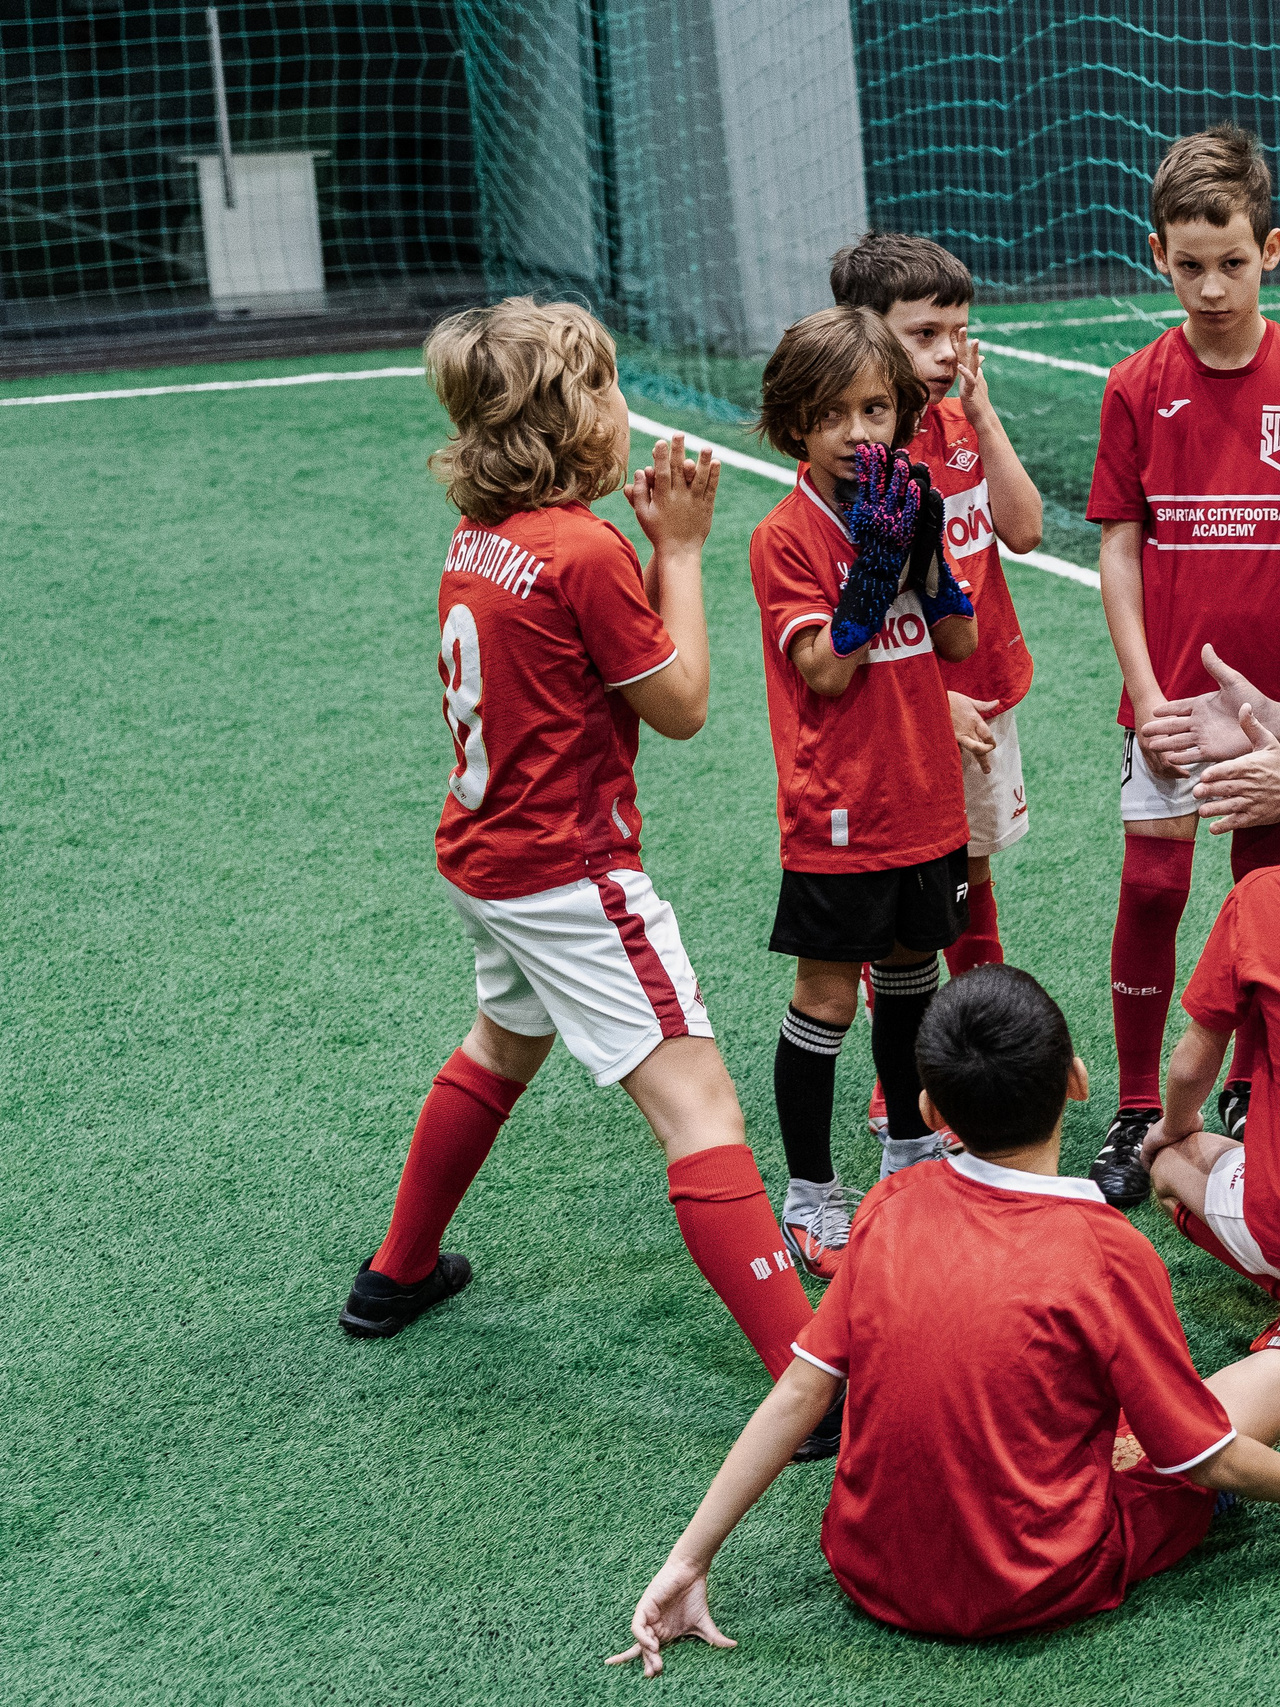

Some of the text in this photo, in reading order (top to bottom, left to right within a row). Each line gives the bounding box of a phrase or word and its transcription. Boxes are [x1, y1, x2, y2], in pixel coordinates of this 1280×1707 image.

[946, 502, 994, 547] ОЙ
[1156, 508, 1205, 521] SPARTAK
[1191, 523, 1257, 537] ACADEMY
[444, 530, 545, 600] СБИУЛЛИН
[441, 603, 490, 811] 8
[1229, 1162, 1245, 1190] ELME
